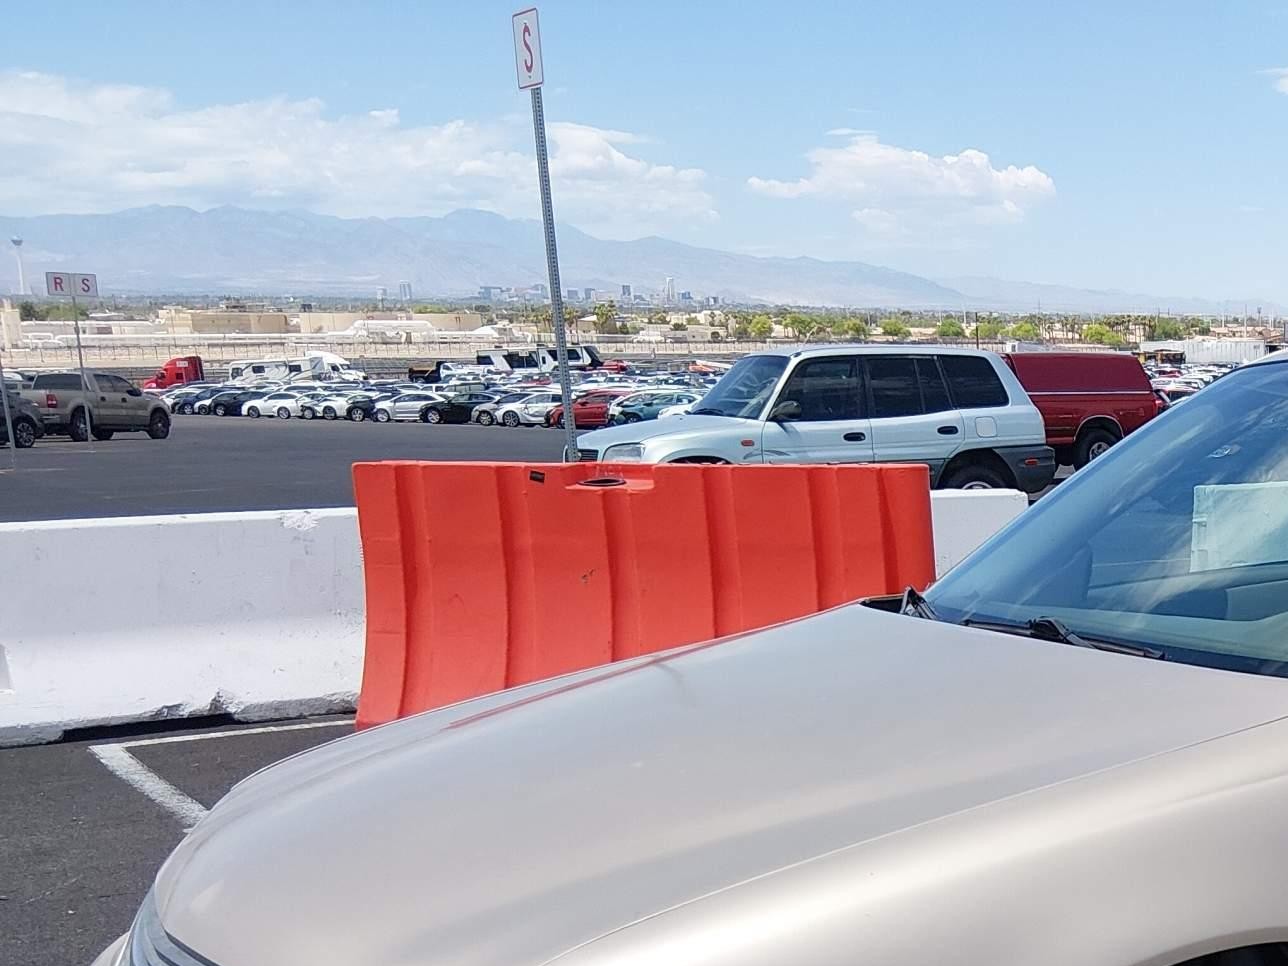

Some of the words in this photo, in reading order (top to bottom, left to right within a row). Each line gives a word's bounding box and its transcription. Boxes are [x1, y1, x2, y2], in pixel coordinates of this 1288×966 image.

[522, 24, 534, 74] S
[54, 276, 64, 292] R
[81, 278, 90, 292] S
